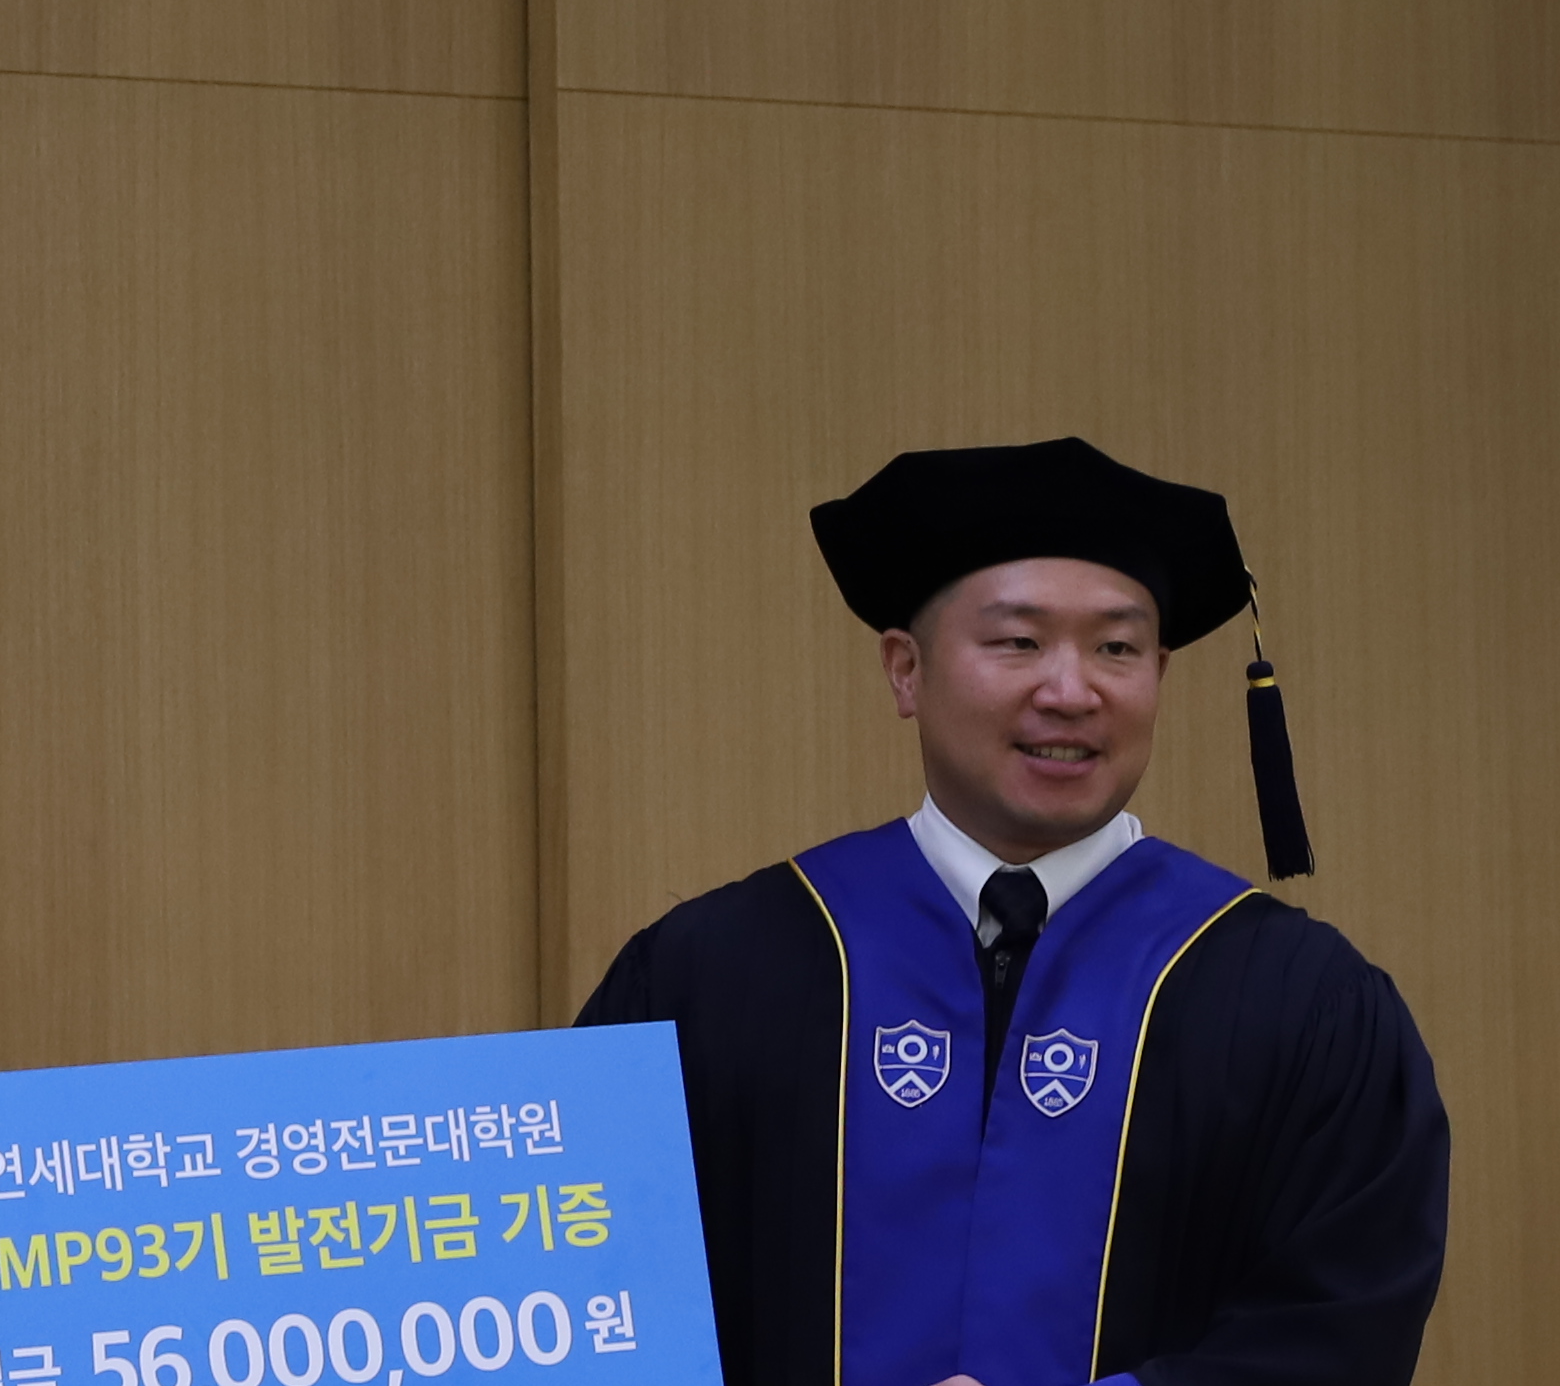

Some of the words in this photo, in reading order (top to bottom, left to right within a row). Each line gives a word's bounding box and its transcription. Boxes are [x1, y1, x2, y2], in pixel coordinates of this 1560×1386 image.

[235, 1099, 564, 1179] 경영전문대학원
[248, 1193, 480, 1276] 발전기금
[500, 1182, 612, 1251] 기증
